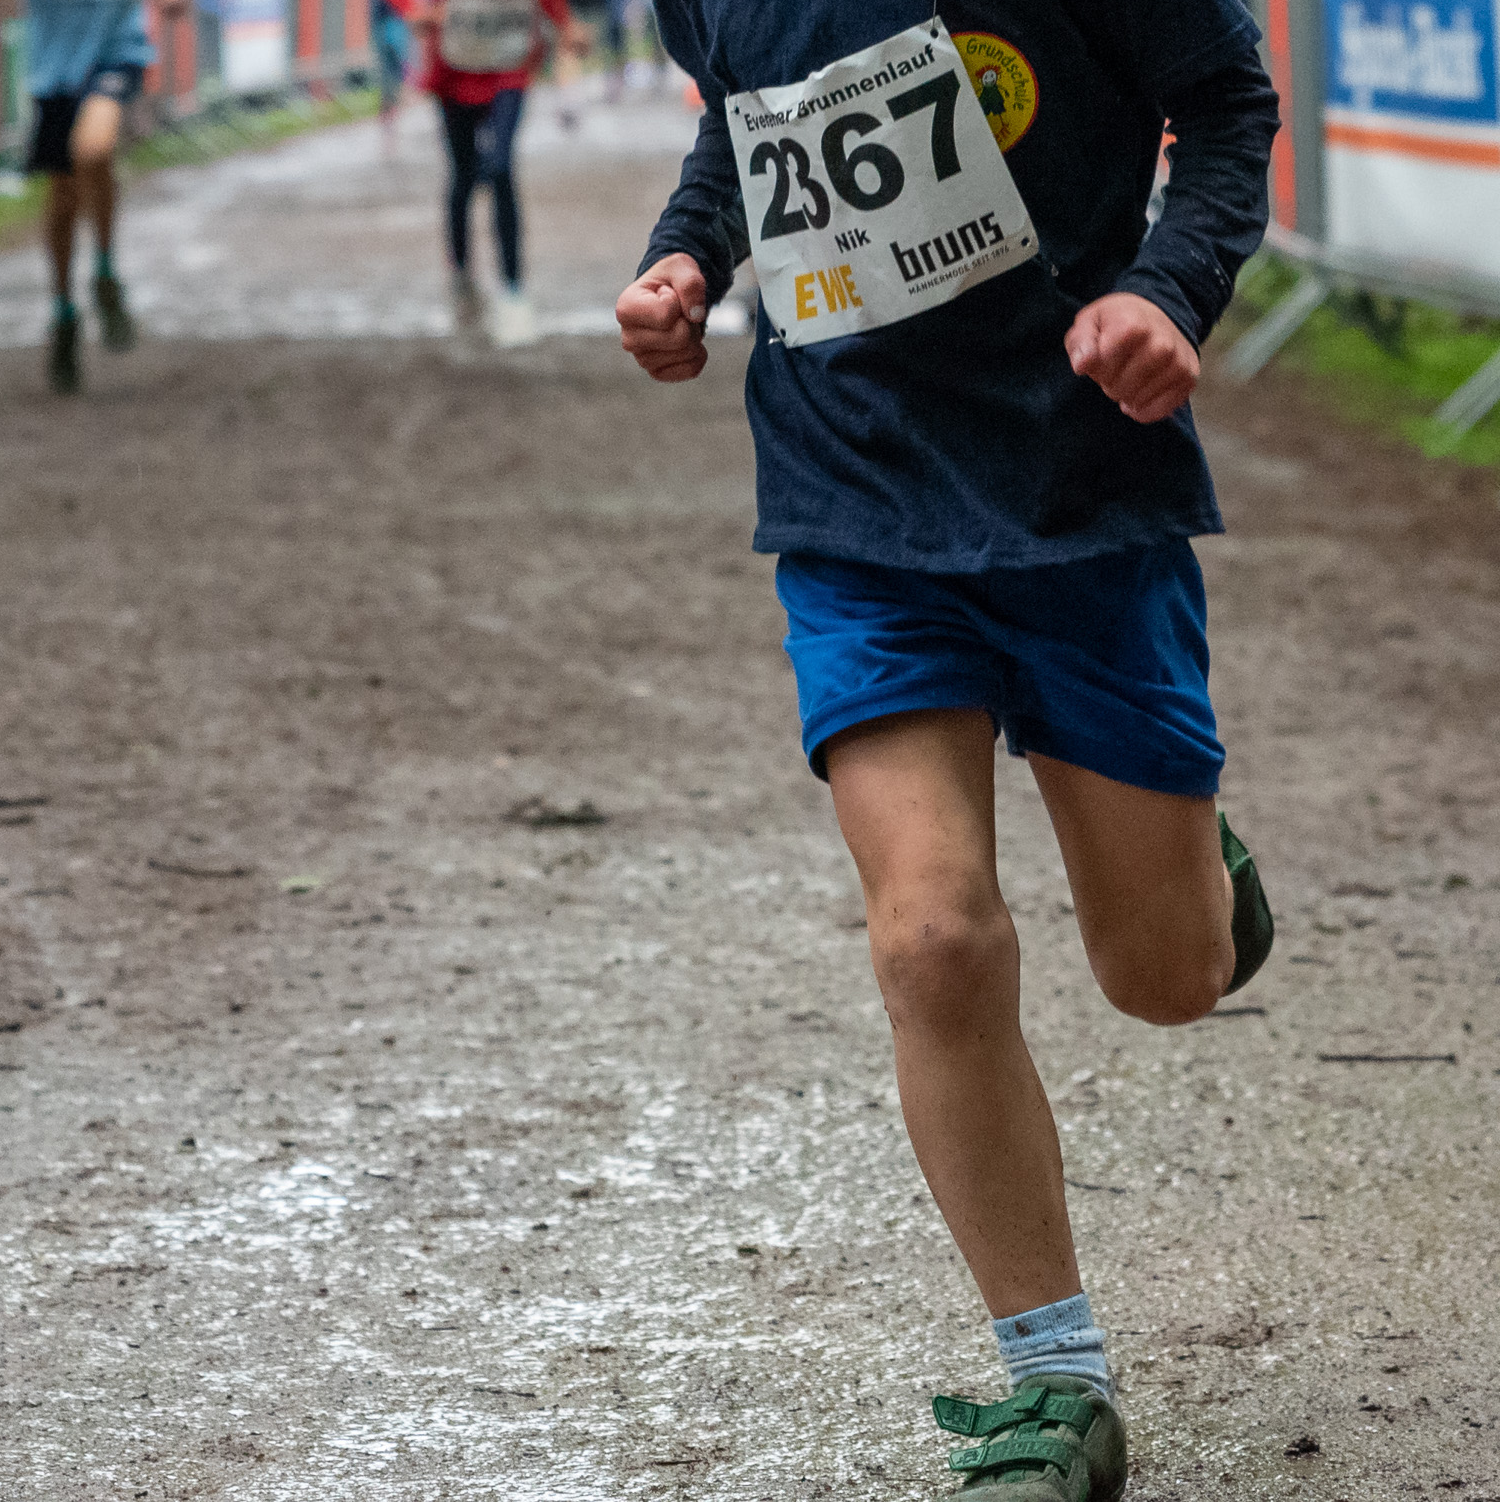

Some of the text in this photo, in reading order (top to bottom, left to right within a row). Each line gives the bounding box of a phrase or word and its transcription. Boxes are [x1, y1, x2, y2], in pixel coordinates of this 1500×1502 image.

[797, 44, 936, 119] Brunnenlauf
[966, 38, 1031, 111] Grundschule
[749, 69, 962, 242] 2367
[834, 227, 871, 255] Nik
[890, 211, 1005, 283] bruns
[794, 264, 863, 321] EWE
